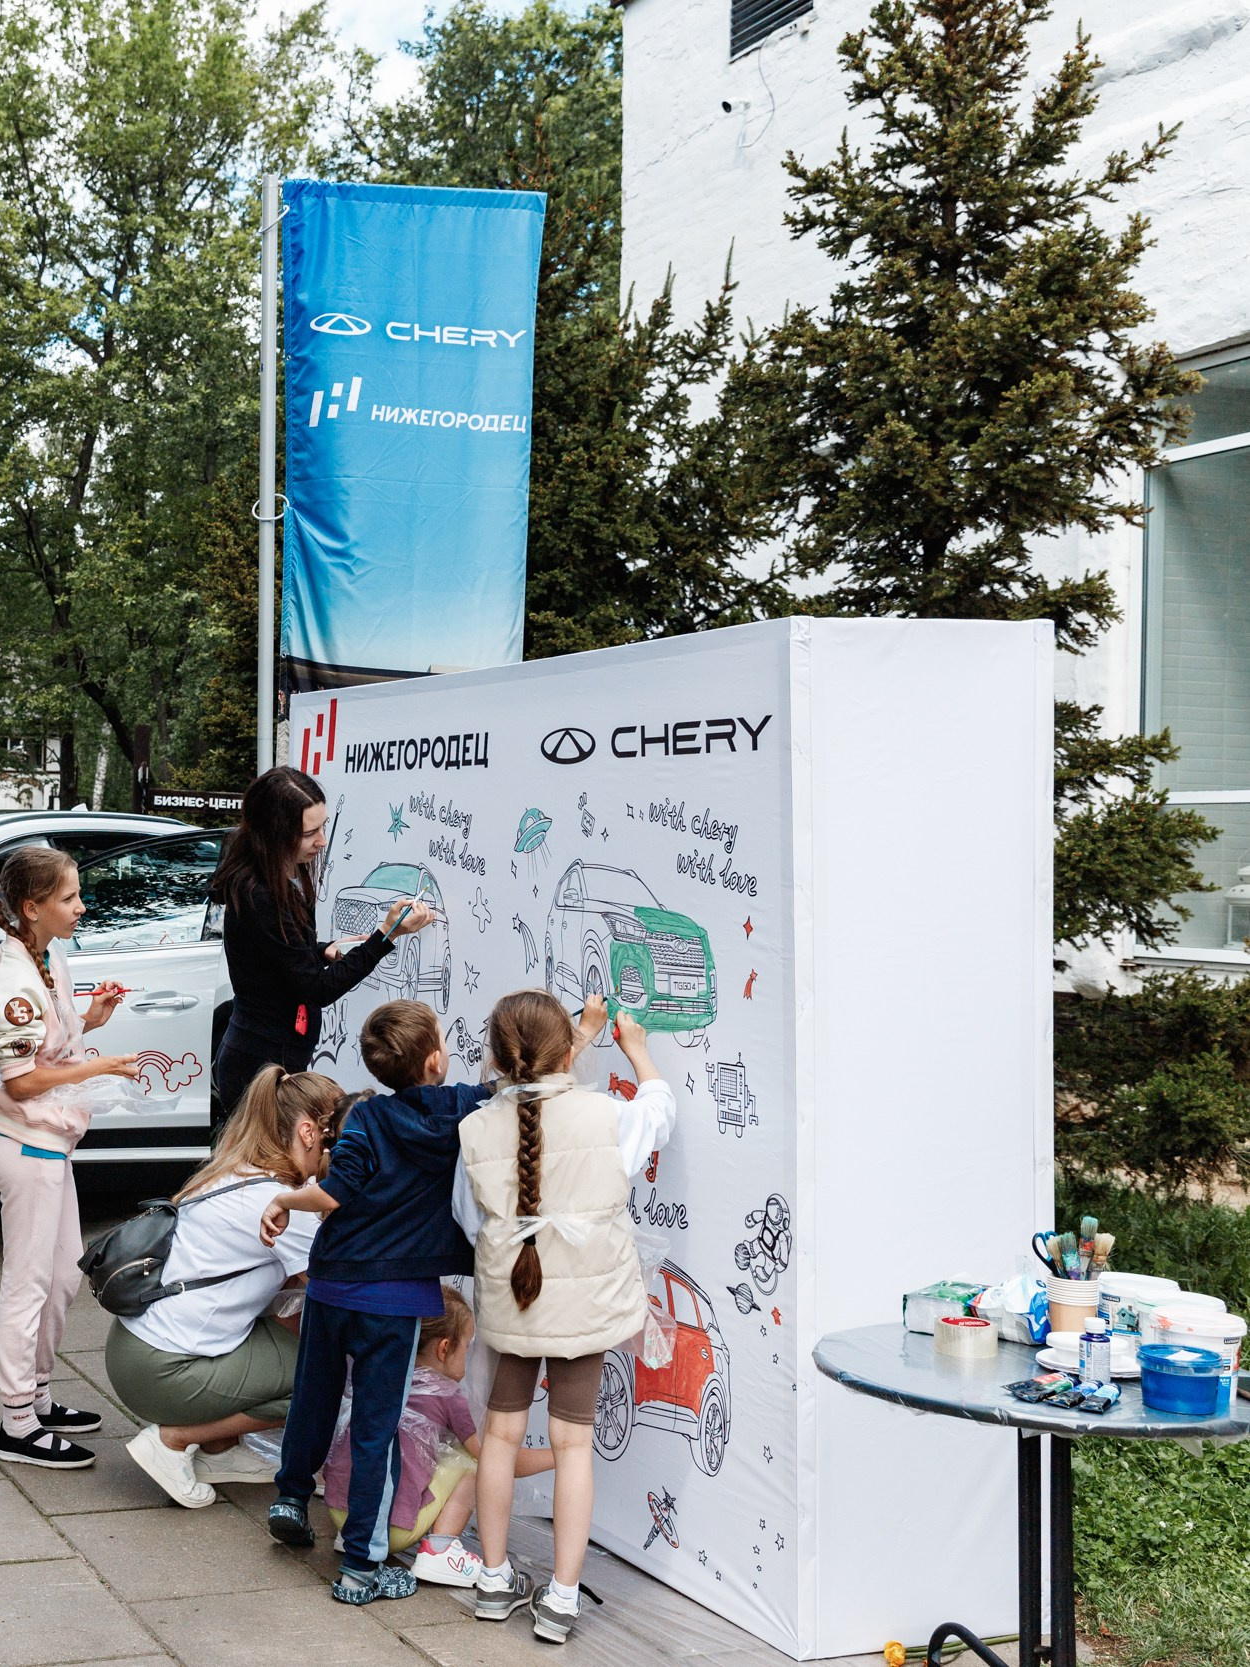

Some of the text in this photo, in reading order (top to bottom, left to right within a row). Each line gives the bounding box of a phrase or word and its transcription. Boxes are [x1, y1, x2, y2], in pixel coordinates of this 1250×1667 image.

[385, 321, 527, 348] CHERY
[370, 404, 527, 434] НИЖЕГОРОДЕЦ
[344, 731, 489, 774] НИЖЕГОРОДЕЦ
[611, 714, 773, 758] CHERY
[409, 790, 472, 839] with chery
[648, 797, 738, 854] with chery
[429, 835, 486, 876] with love
[676, 849, 757, 897] with love
[643, 1187, 689, 1230] love
